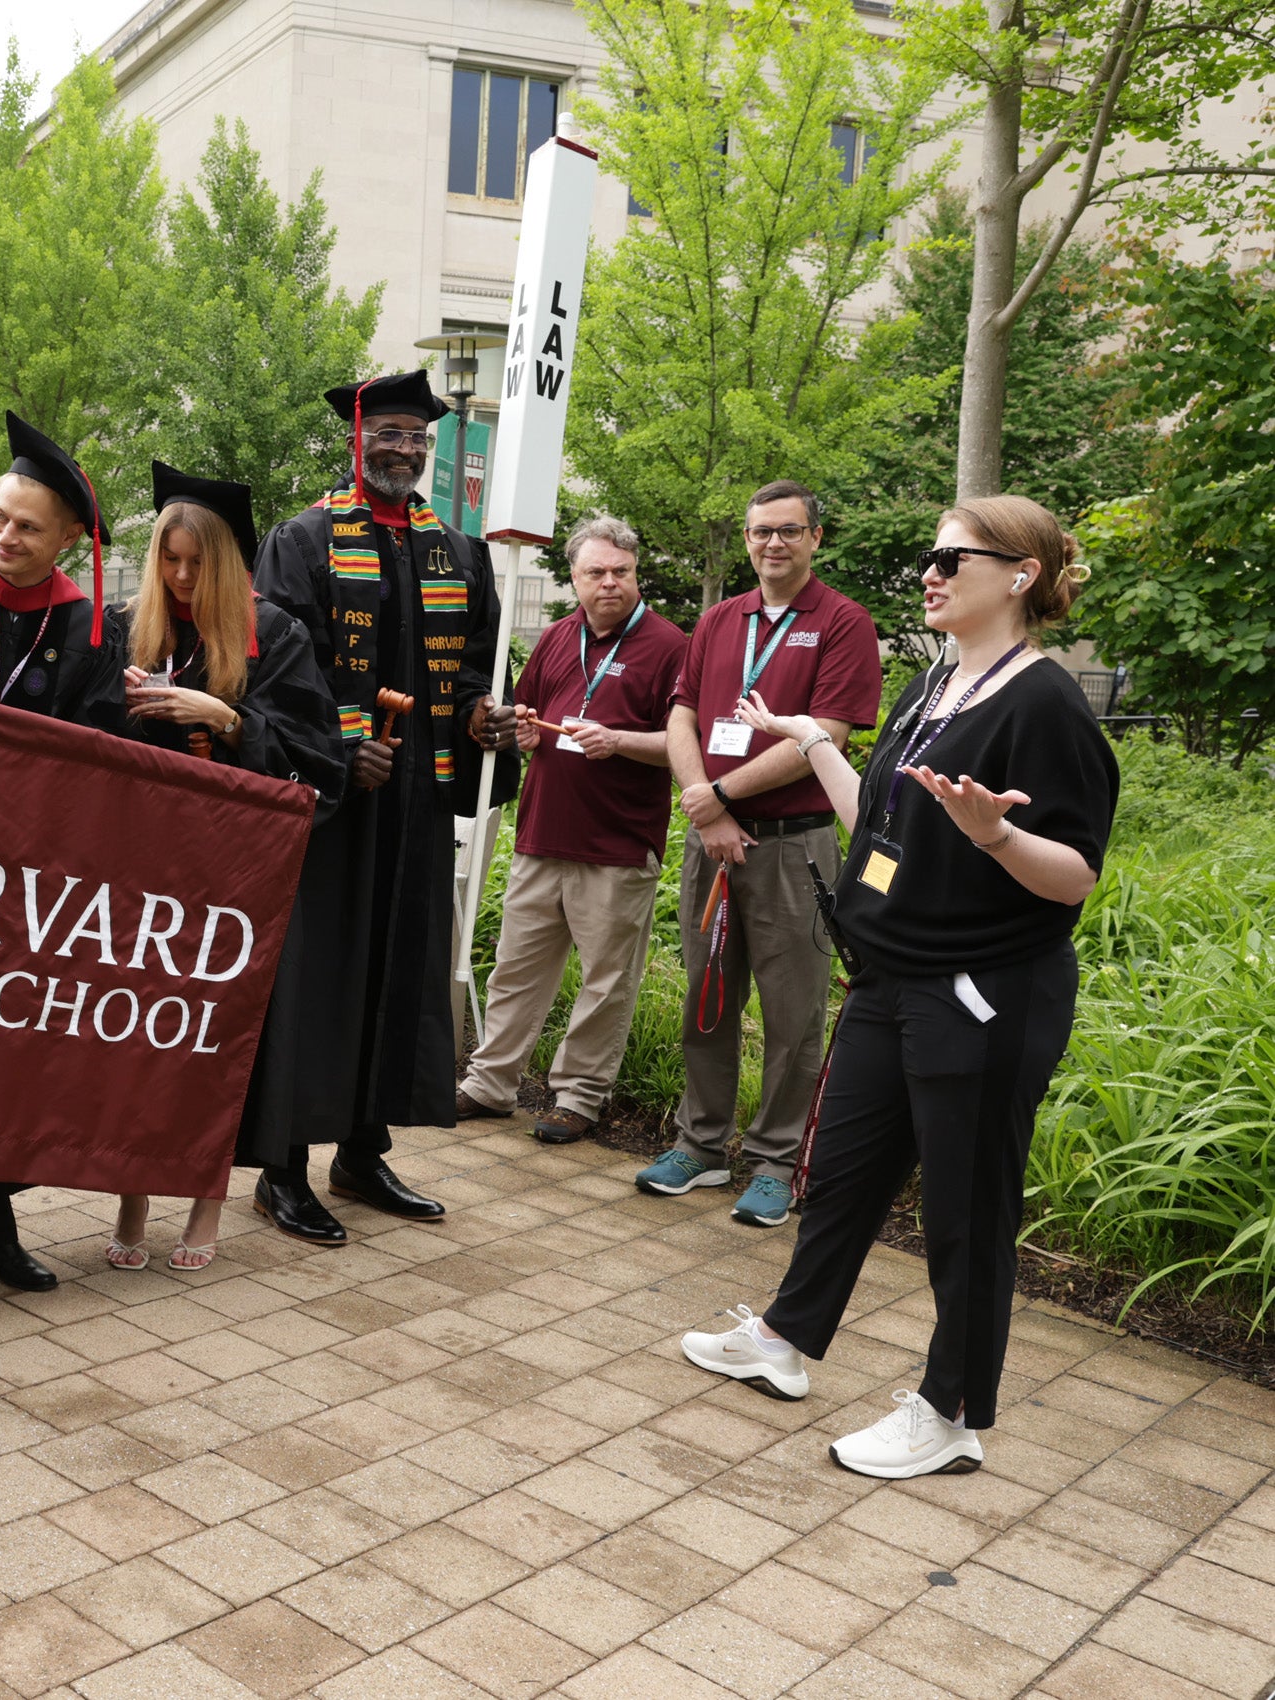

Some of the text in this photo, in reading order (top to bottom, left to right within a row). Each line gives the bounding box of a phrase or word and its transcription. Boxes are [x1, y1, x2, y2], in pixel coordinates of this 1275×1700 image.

[506, 284, 527, 399] LAW
[535, 280, 567, 401] LAW
[788, 631, 820, 641] HARVARD
[440, 681, 452, 694] LA
[909, 682, 947, 744] COMMENCEMENT
[935, 687, 976, 734] UNIVERSITY
